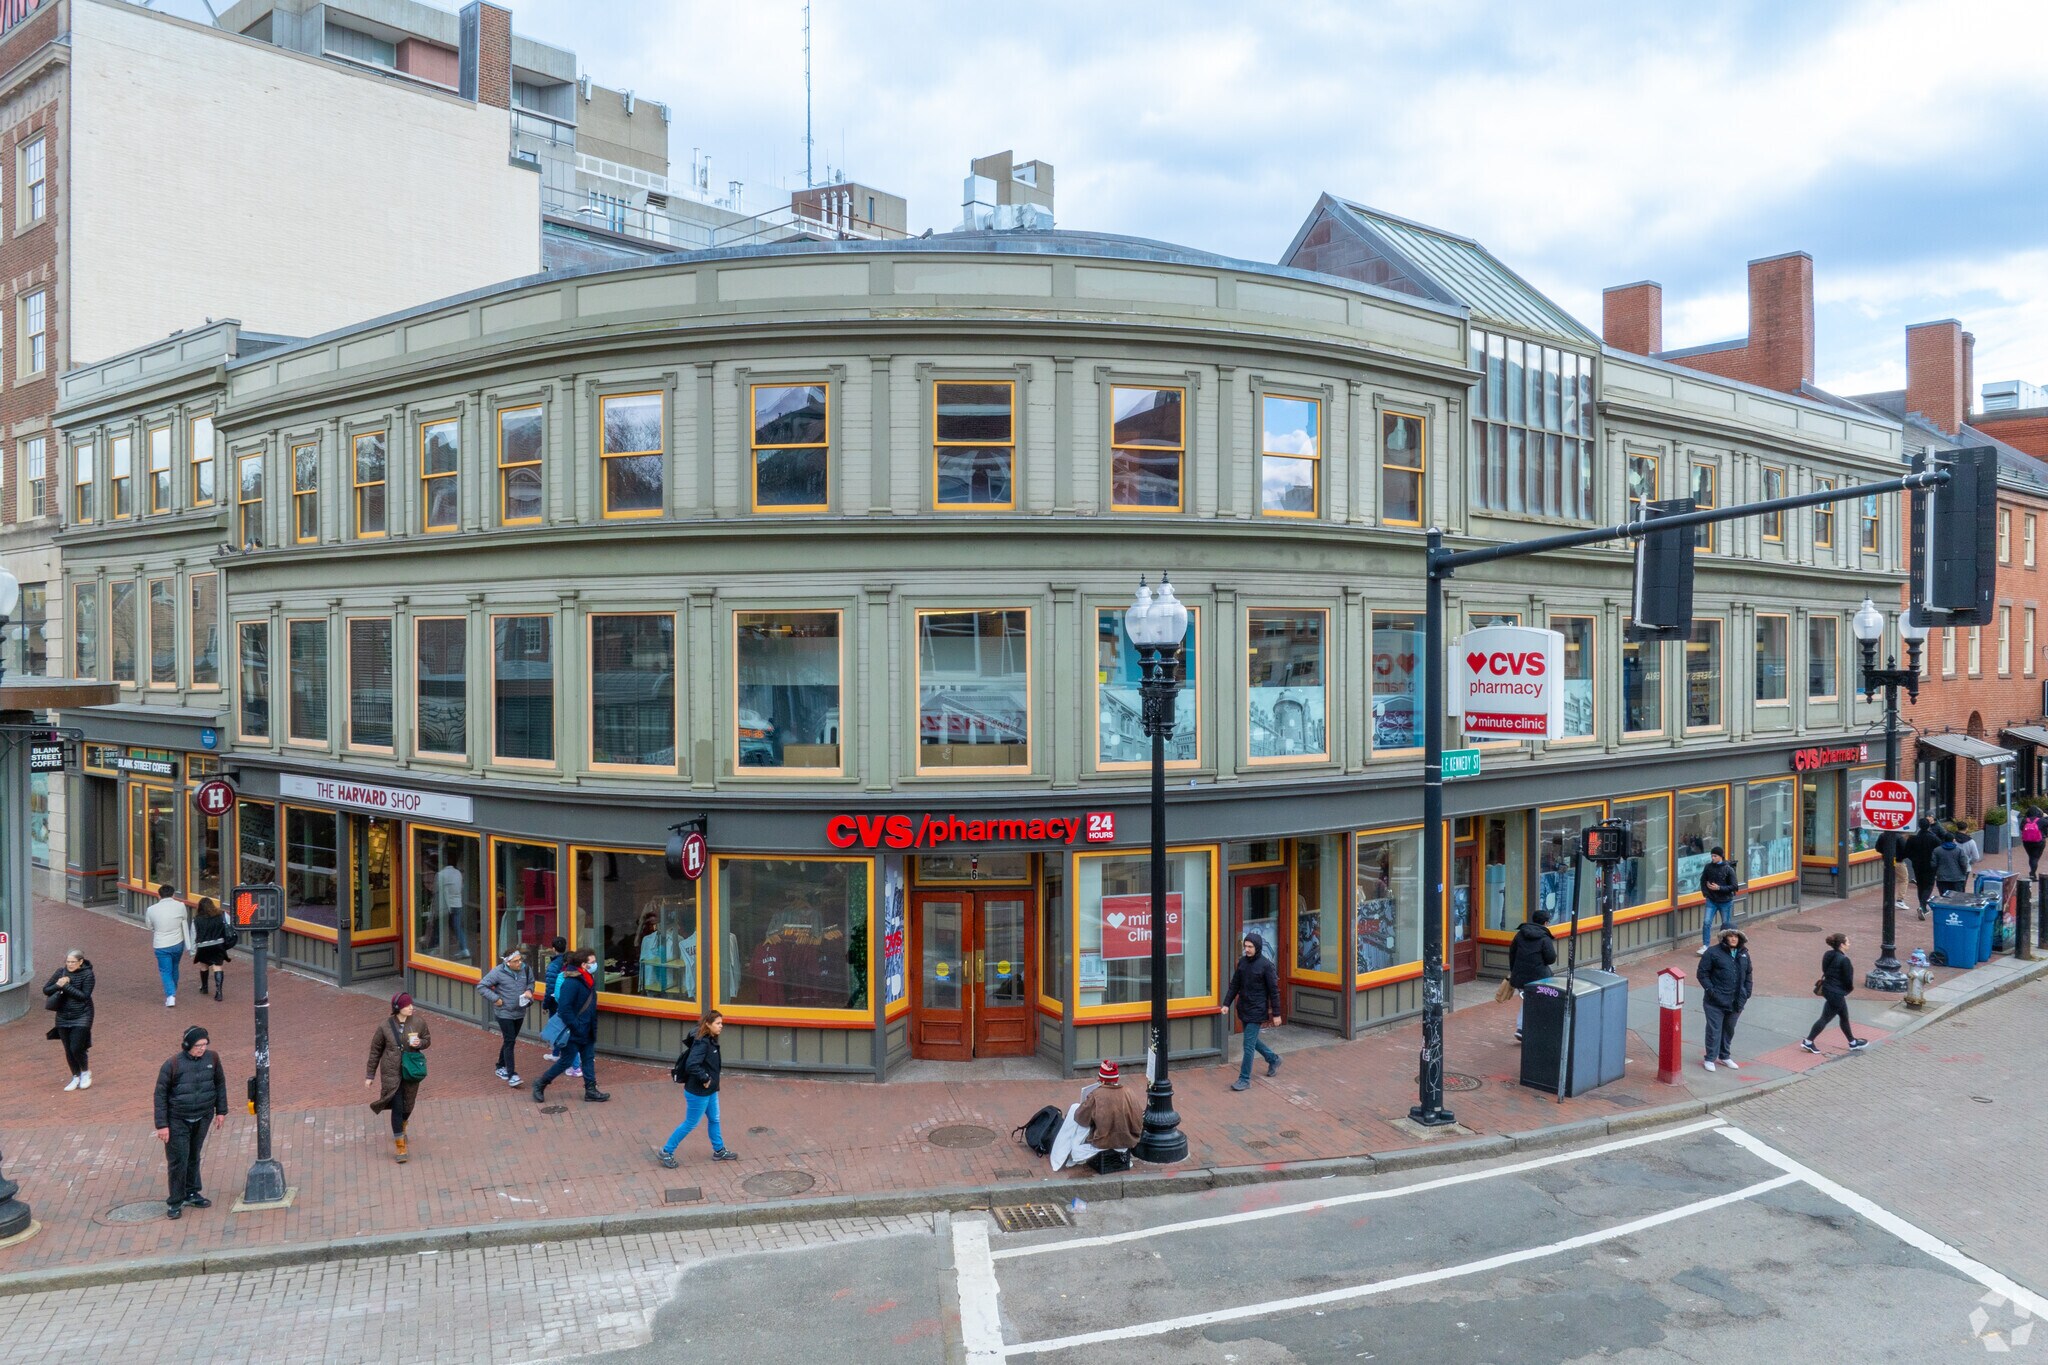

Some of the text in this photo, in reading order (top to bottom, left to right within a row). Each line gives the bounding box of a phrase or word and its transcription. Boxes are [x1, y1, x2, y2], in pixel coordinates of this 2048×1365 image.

[1489, 652, 1546, 676] CVS
[1469, 679, 1543, 698] pharmacy
[1478, 716, 1545, 730] minute clinic
[31, 753, 62, 761] STREET
[32, 747, 60, 755] BLANK
[31, 760, 63, 768] COFFEE
[118, 758, 133, 769] BLANK
[133, 760, 152, 771] STREET
[152, 762, 171, 774] COFFEE
[208, 788, 225, 808] H
[317, 782, 334, 799] THE
[338, 785, 387, 806] HARVARD
[391, 792, 421, 811] SHOP
[1869, 790, 1908, 800] DO NOT
[1089, 815, 1113, 831] 24
[1873, 811, 1904, 822] ENTER
[1089, 831, 1114, 840] HOURS
[688, 841, 700, 871] H
[970, 869, 979, 881] 6
